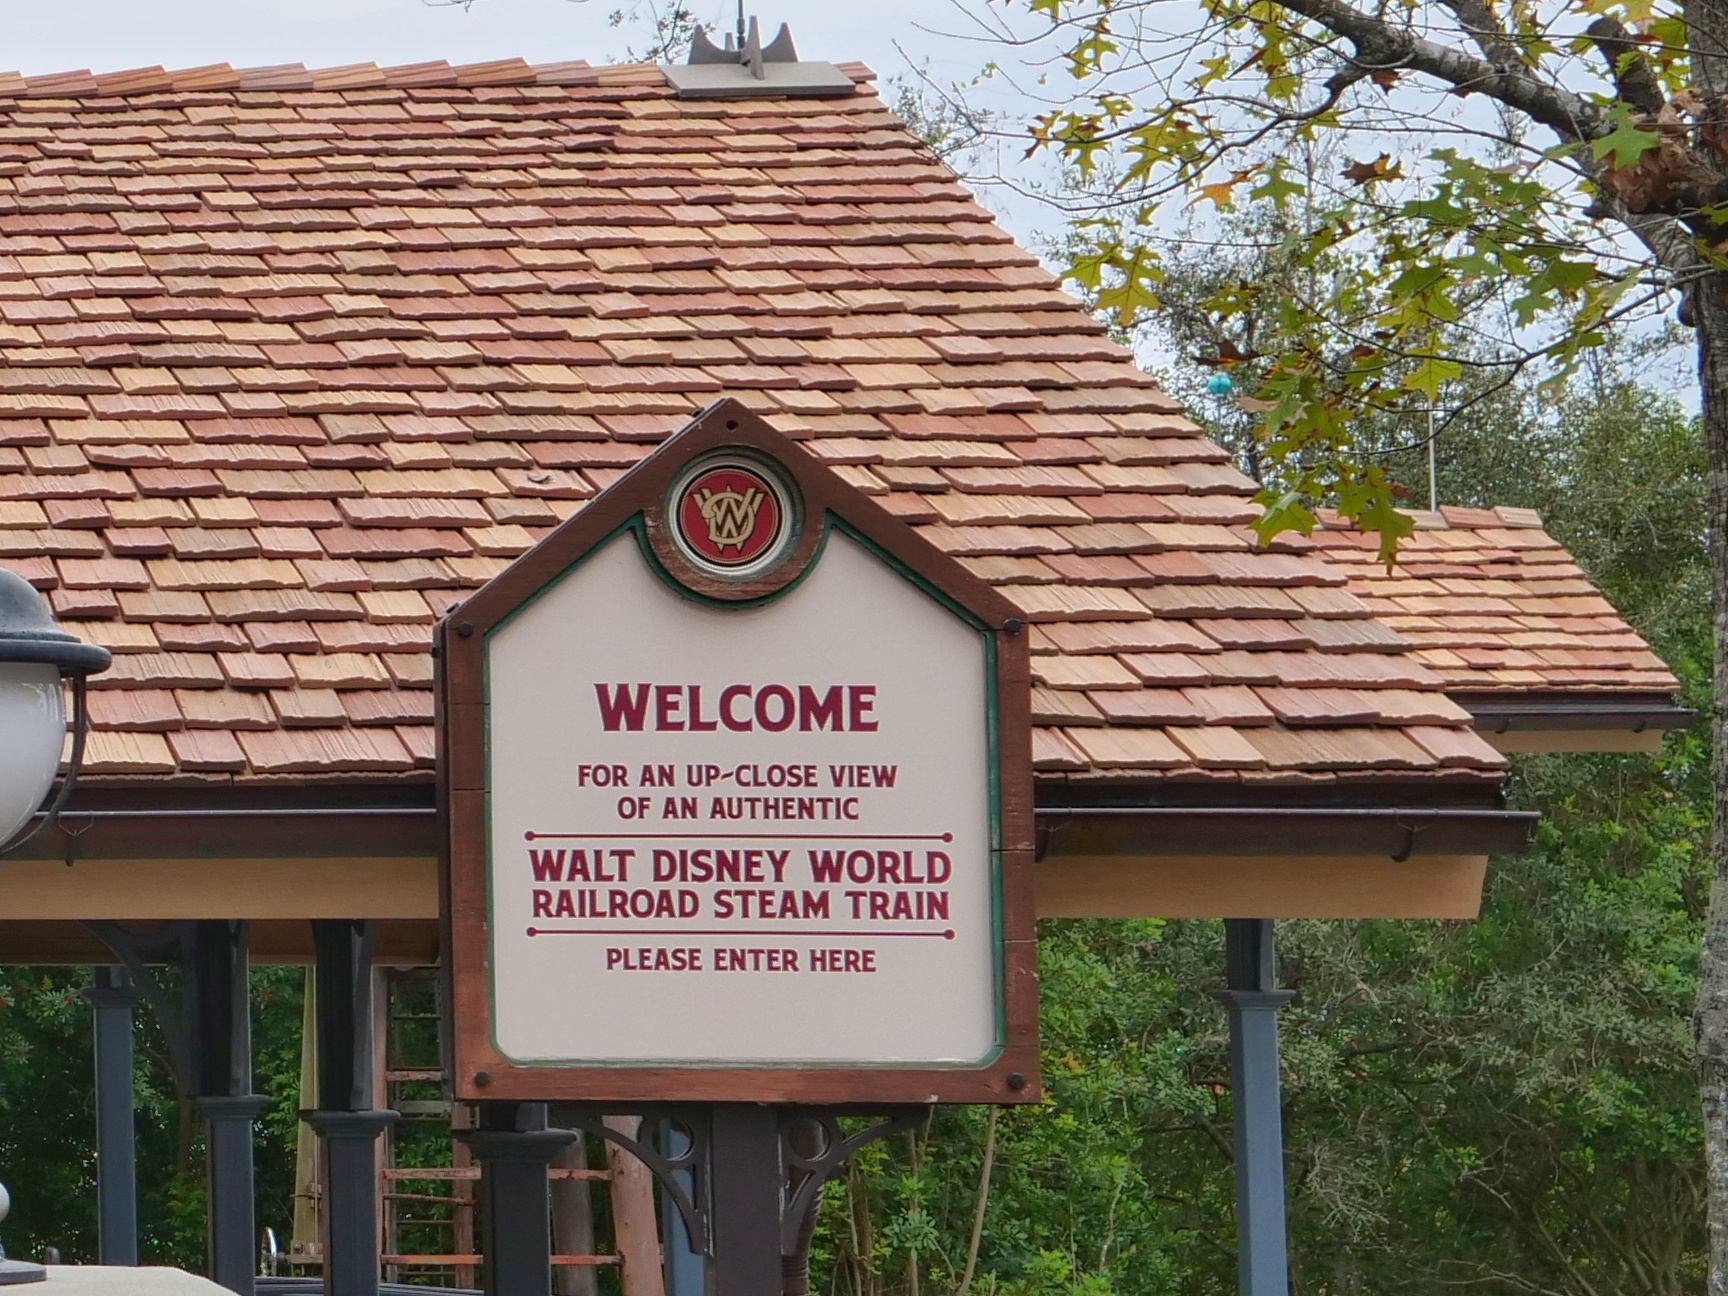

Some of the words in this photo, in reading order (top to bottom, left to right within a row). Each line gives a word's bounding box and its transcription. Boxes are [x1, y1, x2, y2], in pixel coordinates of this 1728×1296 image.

[594, 683, 880, 732] WELCOME
[577, 764, 629, 787] FOR
[639, 764, 675, 787] AN
[686, 764, 818, 787] UP-CLOSE
[828, 765, 898, 788] VIEW
[617, 797, 651, 820] OF
[662, 797, 698, 820] AN
[709, 797, 860, 820] AUTHENTIC
[528, 849, 636, 883] WALT
[652, 849, 791, 883] DISNEY
[807, 850, 952, 884] WORLD
[531, 889, 700, 918] RAILROAD
[713, 890, 830, 919] STEAM
[844, 890, 950, 920] TRAIN
[606, 947, 702, 971] PLEASE
[713, 948, 799, 972] ENTER
[809, 949, 876, 973] HERE
